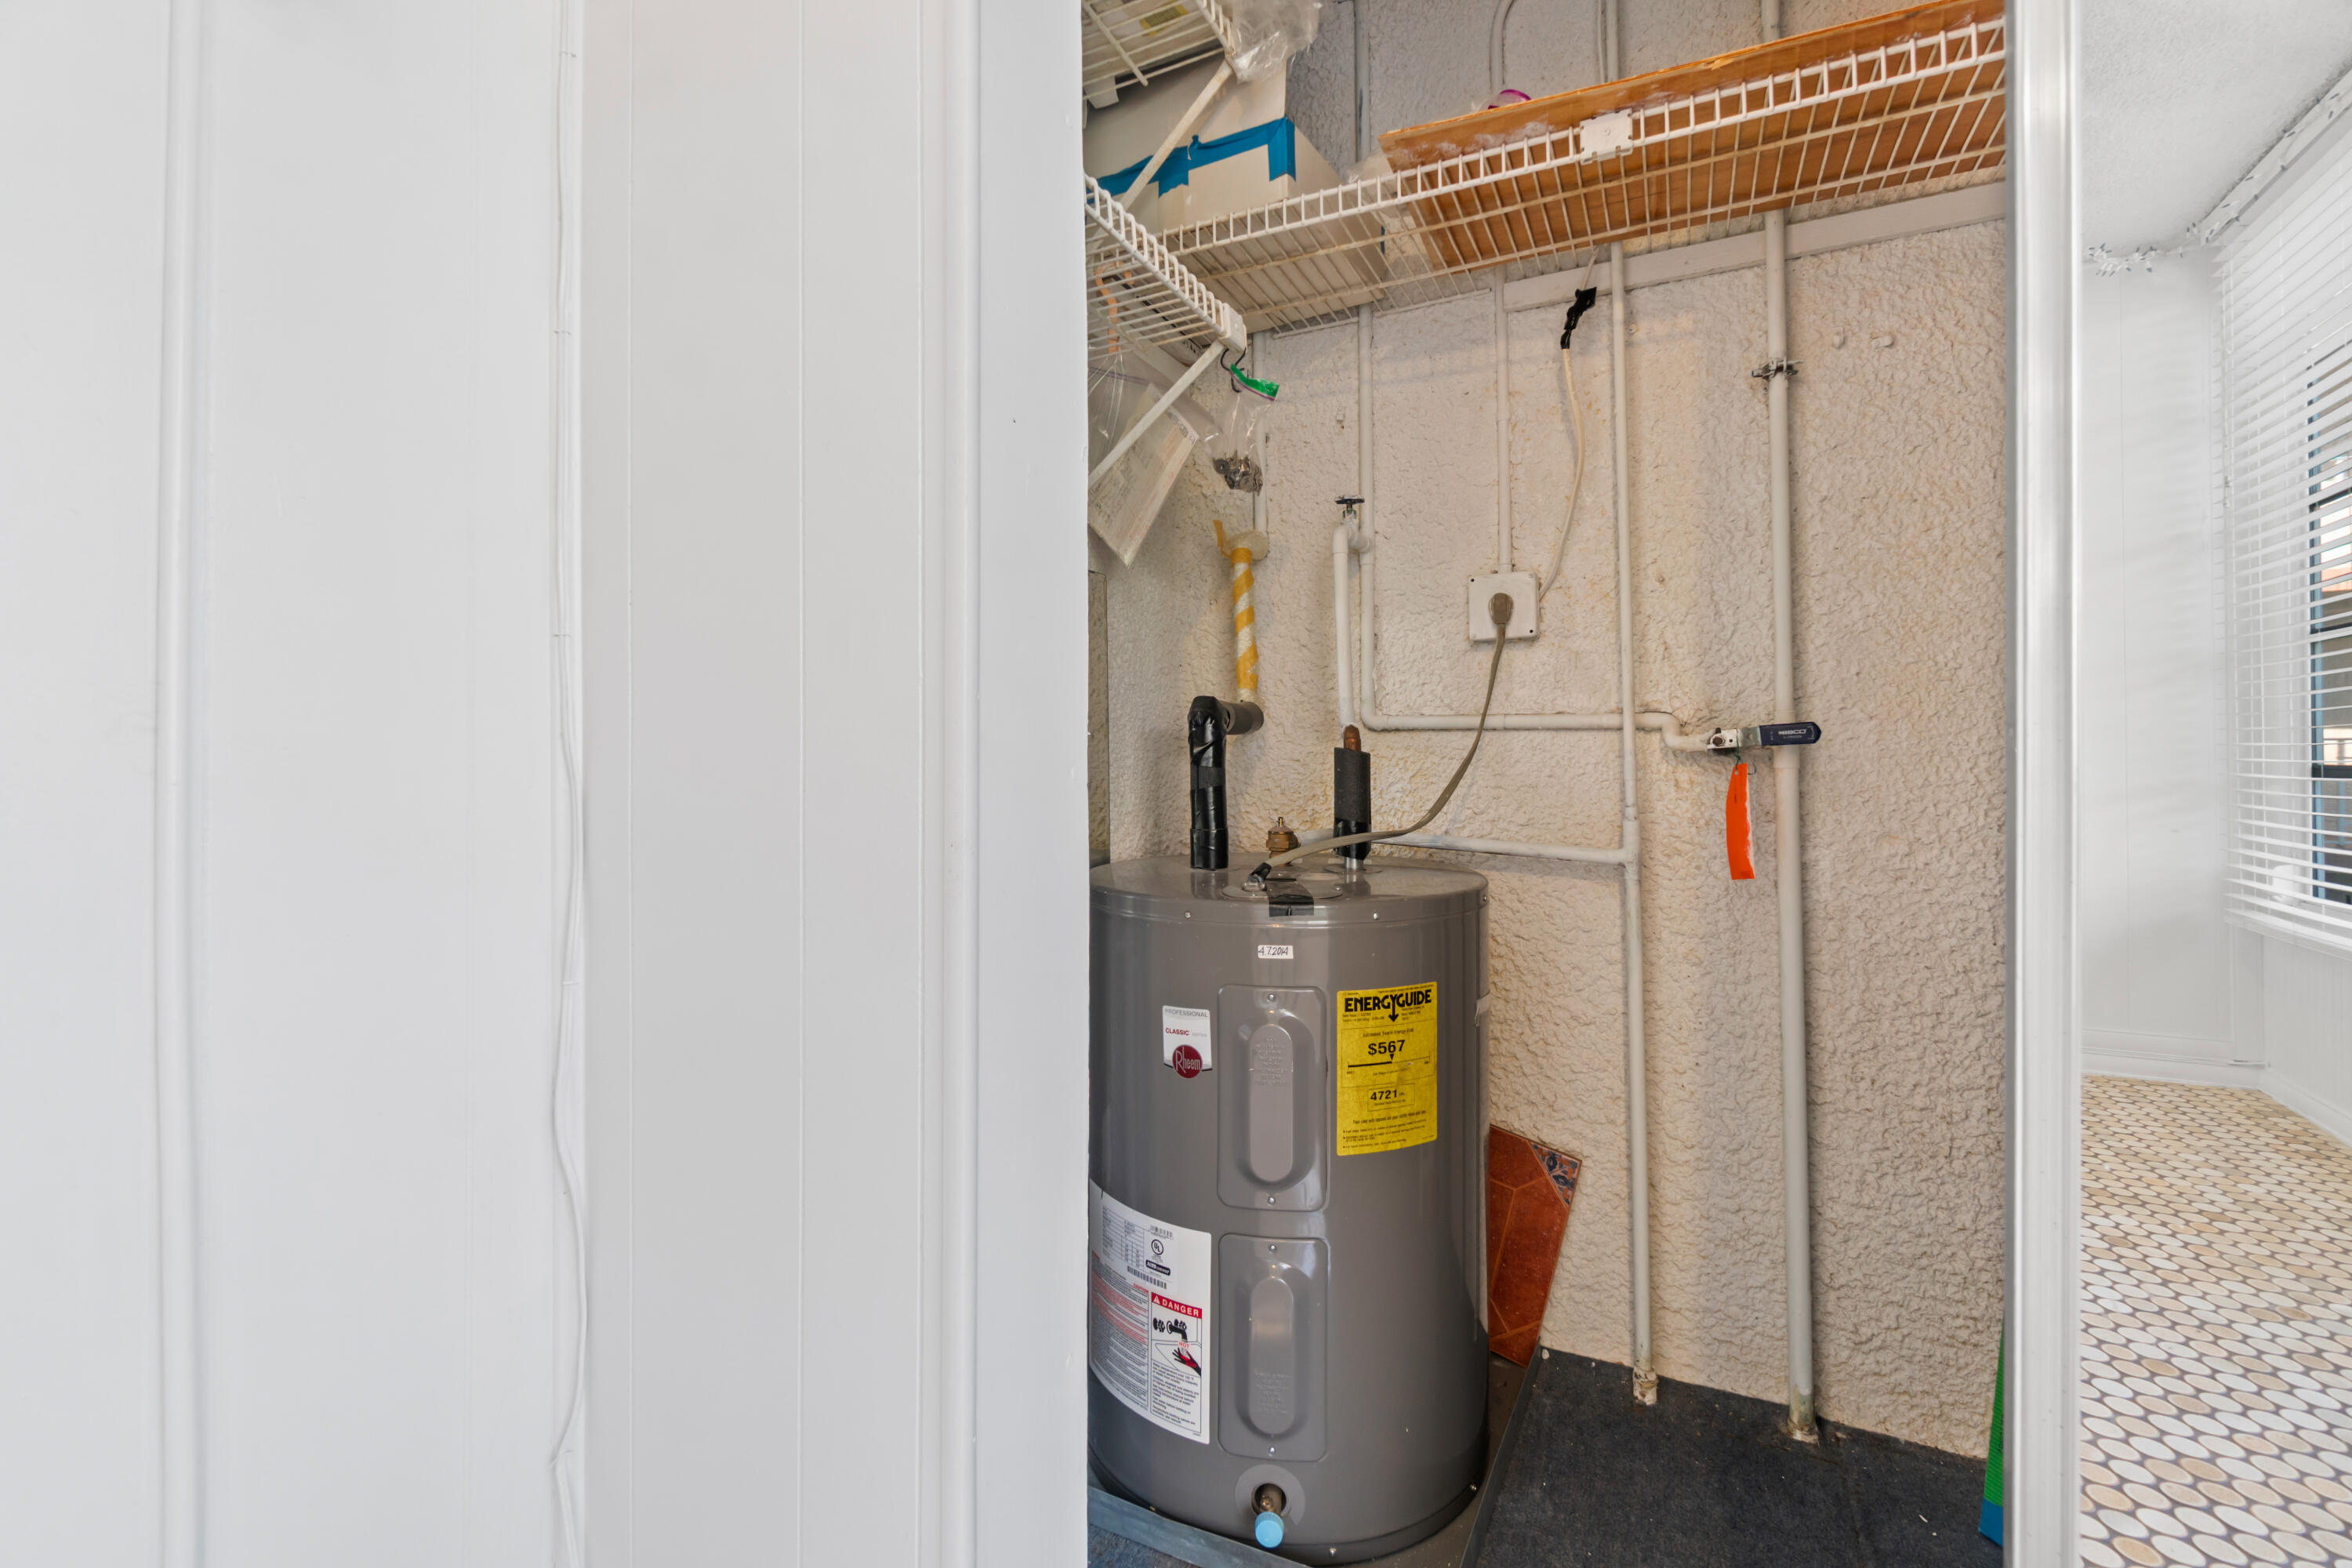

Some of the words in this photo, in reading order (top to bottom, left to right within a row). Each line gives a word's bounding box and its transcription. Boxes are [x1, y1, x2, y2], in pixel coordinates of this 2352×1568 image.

[1345, 989, 1432, 1013] ENERGYGUIDE
[1164, 1008, 1208, 1018] PROFESSIONAL
[1368, 1040, 1406, 1056] $567
[1176, 1046, 1201, 1073] Rheem
[1370, 1089, 1397, 1101] 4721
[1162, 1298, 1199, 1317] DANGER
